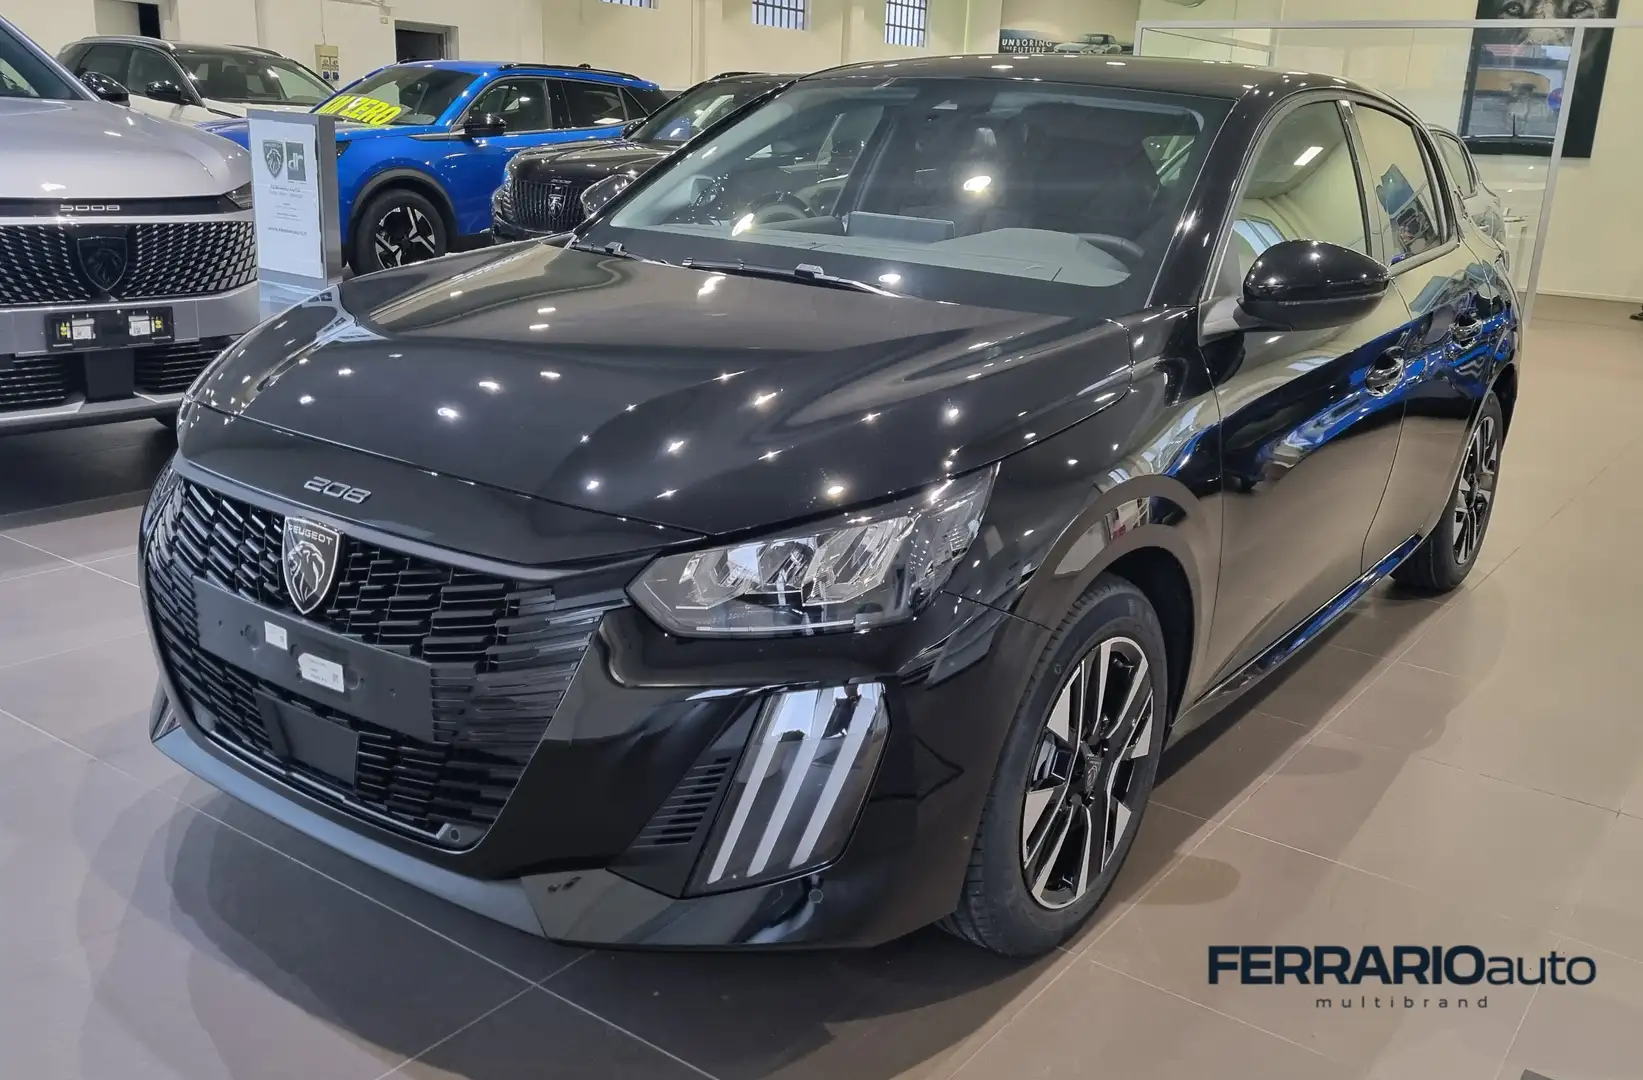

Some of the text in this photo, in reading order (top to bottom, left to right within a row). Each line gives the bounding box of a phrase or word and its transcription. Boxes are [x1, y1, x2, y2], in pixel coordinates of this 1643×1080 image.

[1001, 39, 1052, 47] UNBORING
[338, 96, 401, 126] ZERO
[304, 476, 372, 504] 208
[288, 524, 333, 546] PEUGEOT
